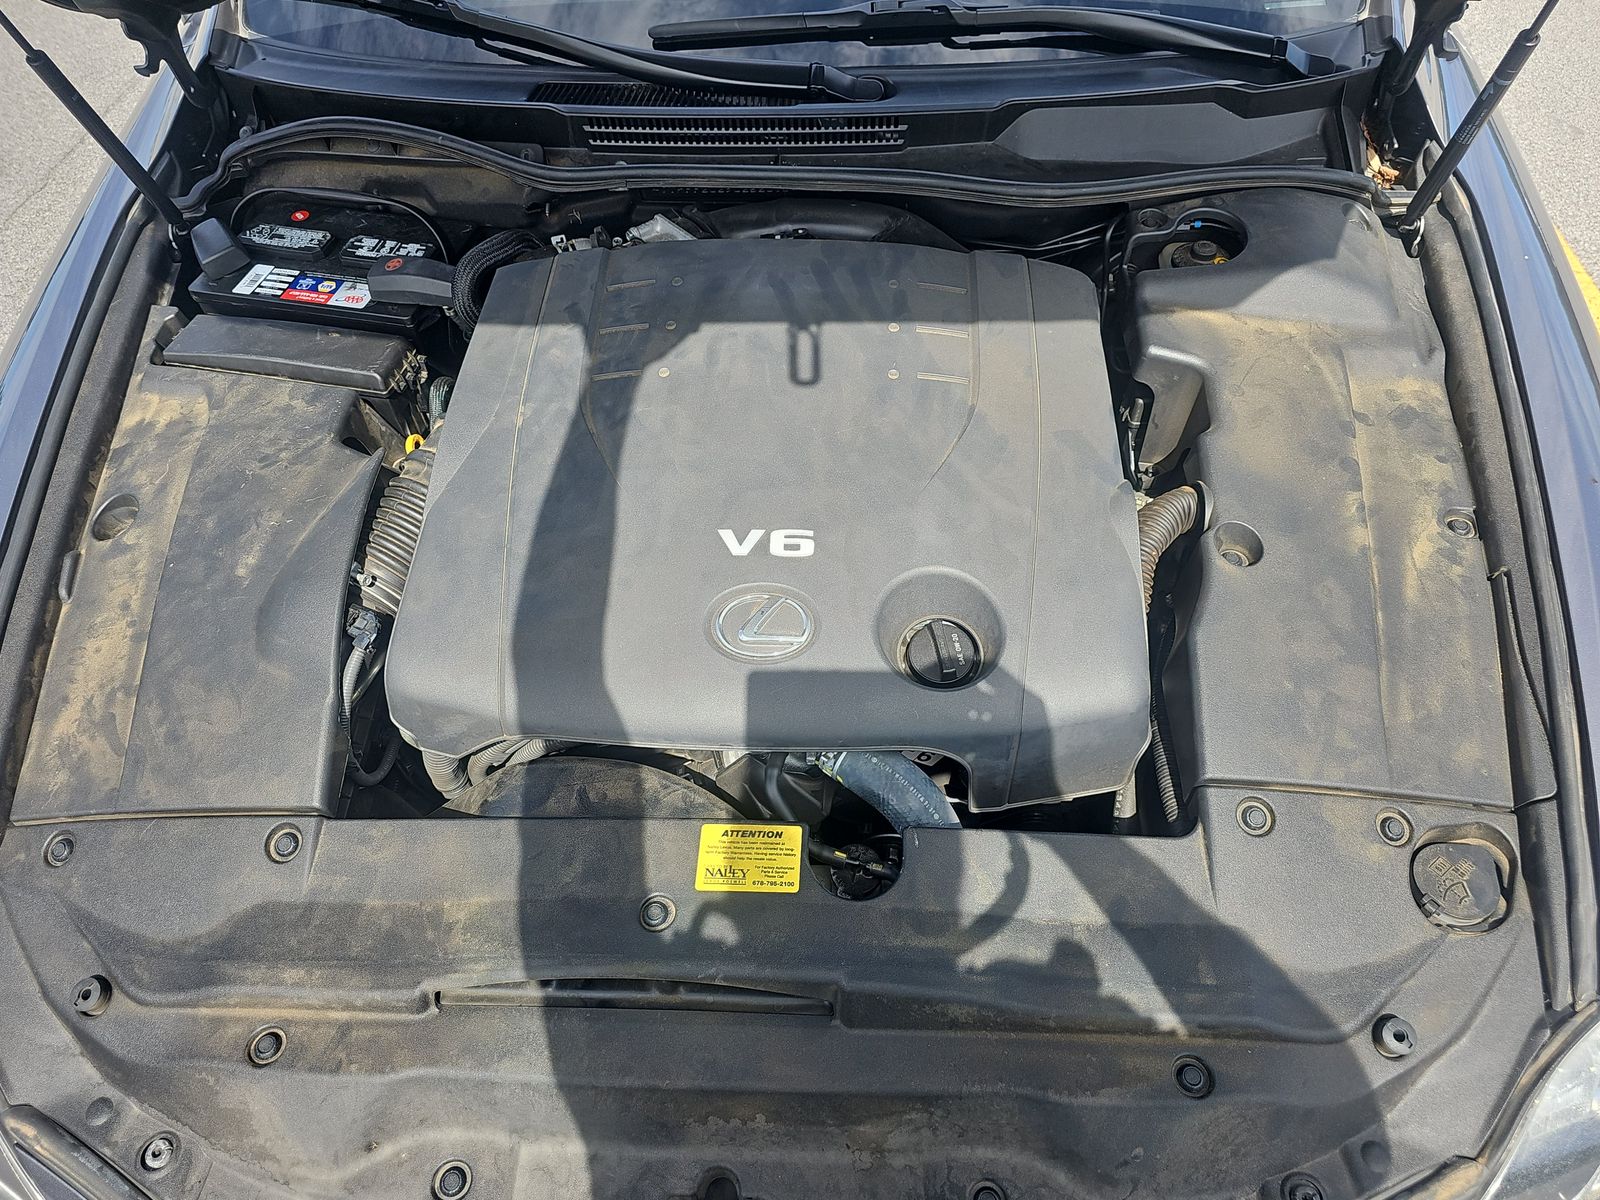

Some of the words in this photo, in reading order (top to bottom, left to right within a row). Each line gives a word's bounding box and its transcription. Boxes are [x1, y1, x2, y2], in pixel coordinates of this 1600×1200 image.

[717, 529, 814, 558] V6
[951, 633, 961, 652] 0W-20
[957, 653, 966, 665] SAE
[722, 830, 783, 838] ATTENTION
[705, 865, 750, 878] NALLEY
